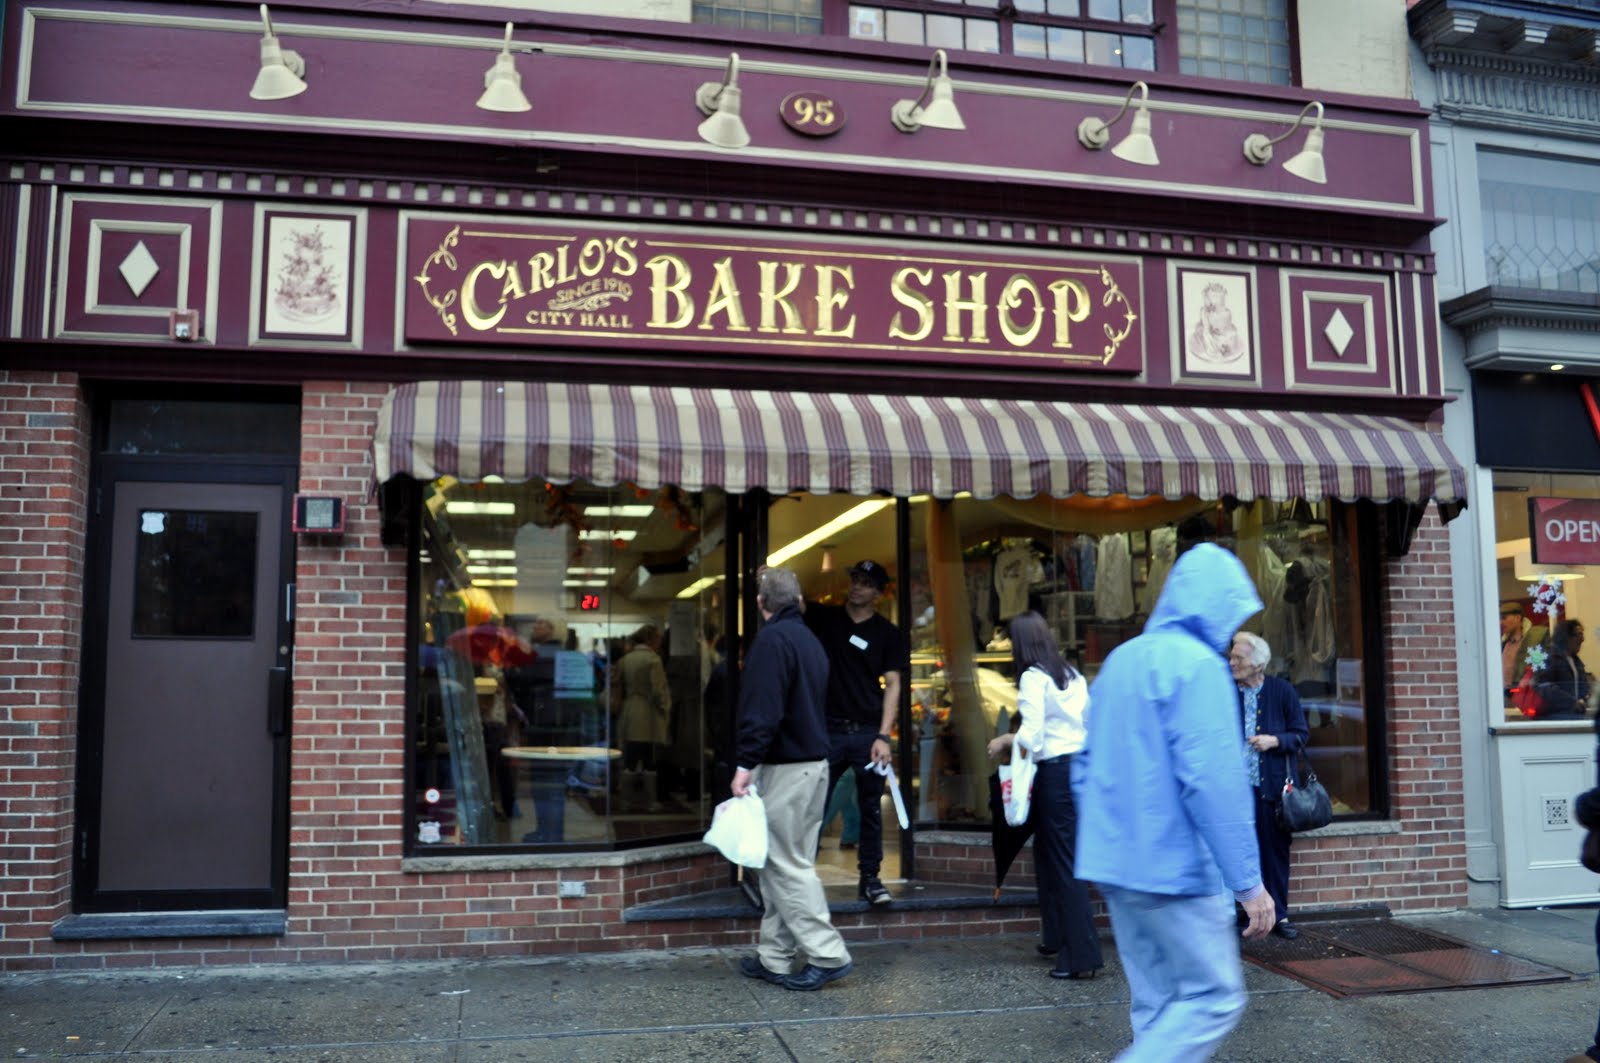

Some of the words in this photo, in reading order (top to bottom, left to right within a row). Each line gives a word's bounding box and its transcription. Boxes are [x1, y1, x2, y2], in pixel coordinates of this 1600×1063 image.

[794, 97, 834, 126] 95
[461, 236, 638, 331] CARLO'S
[644, 254, 856, 338] BAKE
[889, 267, 1091, 348] SHOP
[556, 279, 601, 303] SINCE
[603, 277, 633, 297] 1910
[526, 310, 574, 325] CITY
[580, 312, 633, 328] HALL
